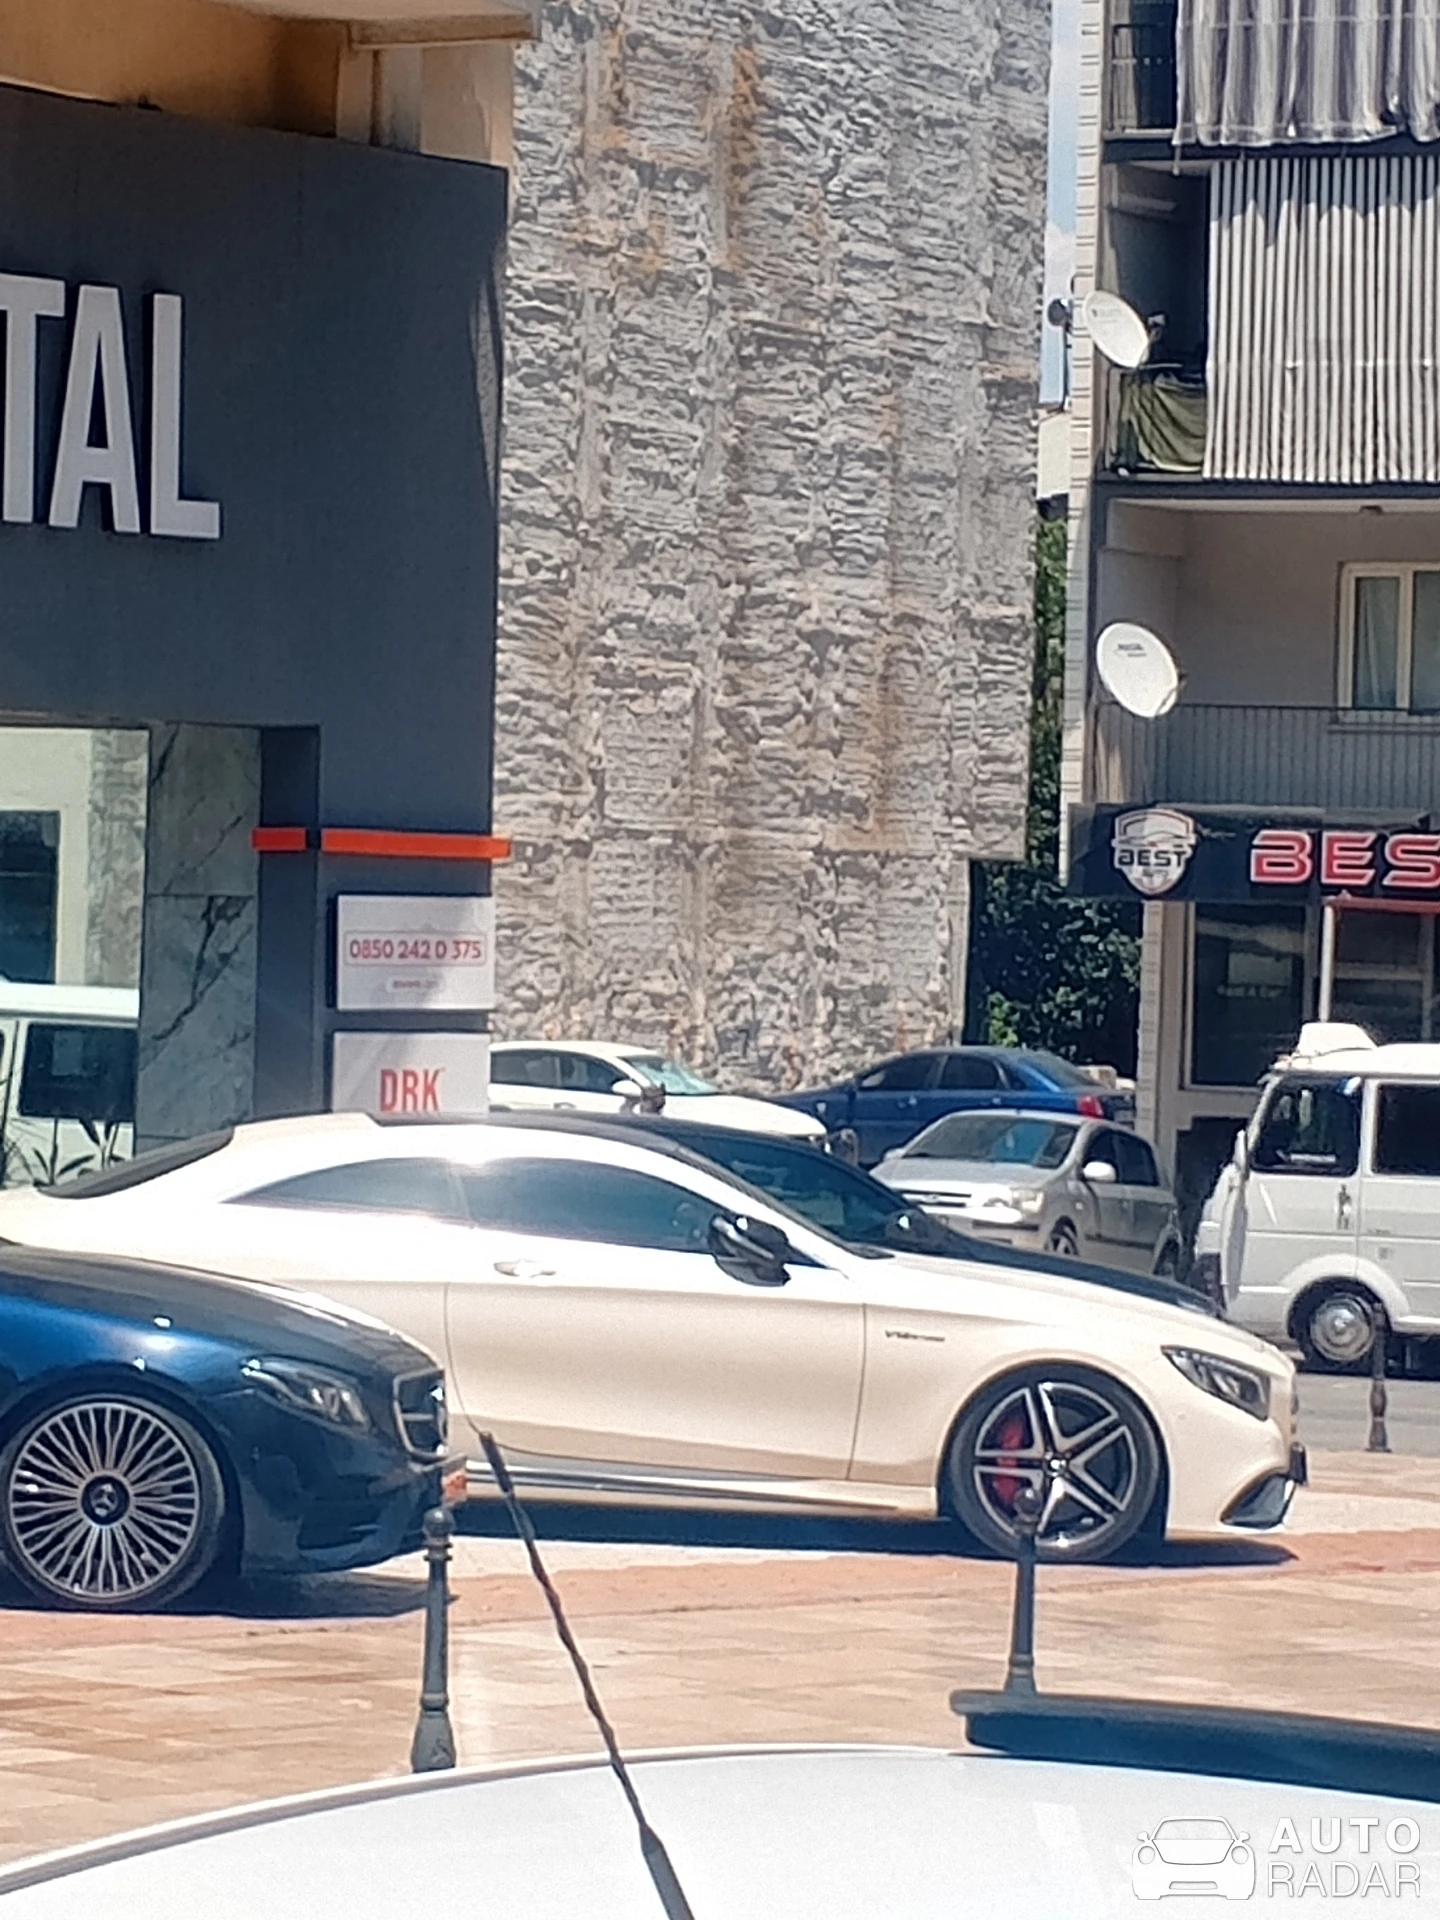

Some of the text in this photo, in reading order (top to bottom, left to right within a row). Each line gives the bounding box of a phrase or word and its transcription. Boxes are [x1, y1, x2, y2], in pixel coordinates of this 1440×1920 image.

[0, 272, 220, 539] TAL
[1117, 848, 1188, 868] BEST
[1250, 829, 1440, 888] BES
[350, 939, 395, 959] 0850
[397, 939, 431, 959] 242
[451, 940, 482, 960] 375
[380, 1068, 441, 1112] DRK
